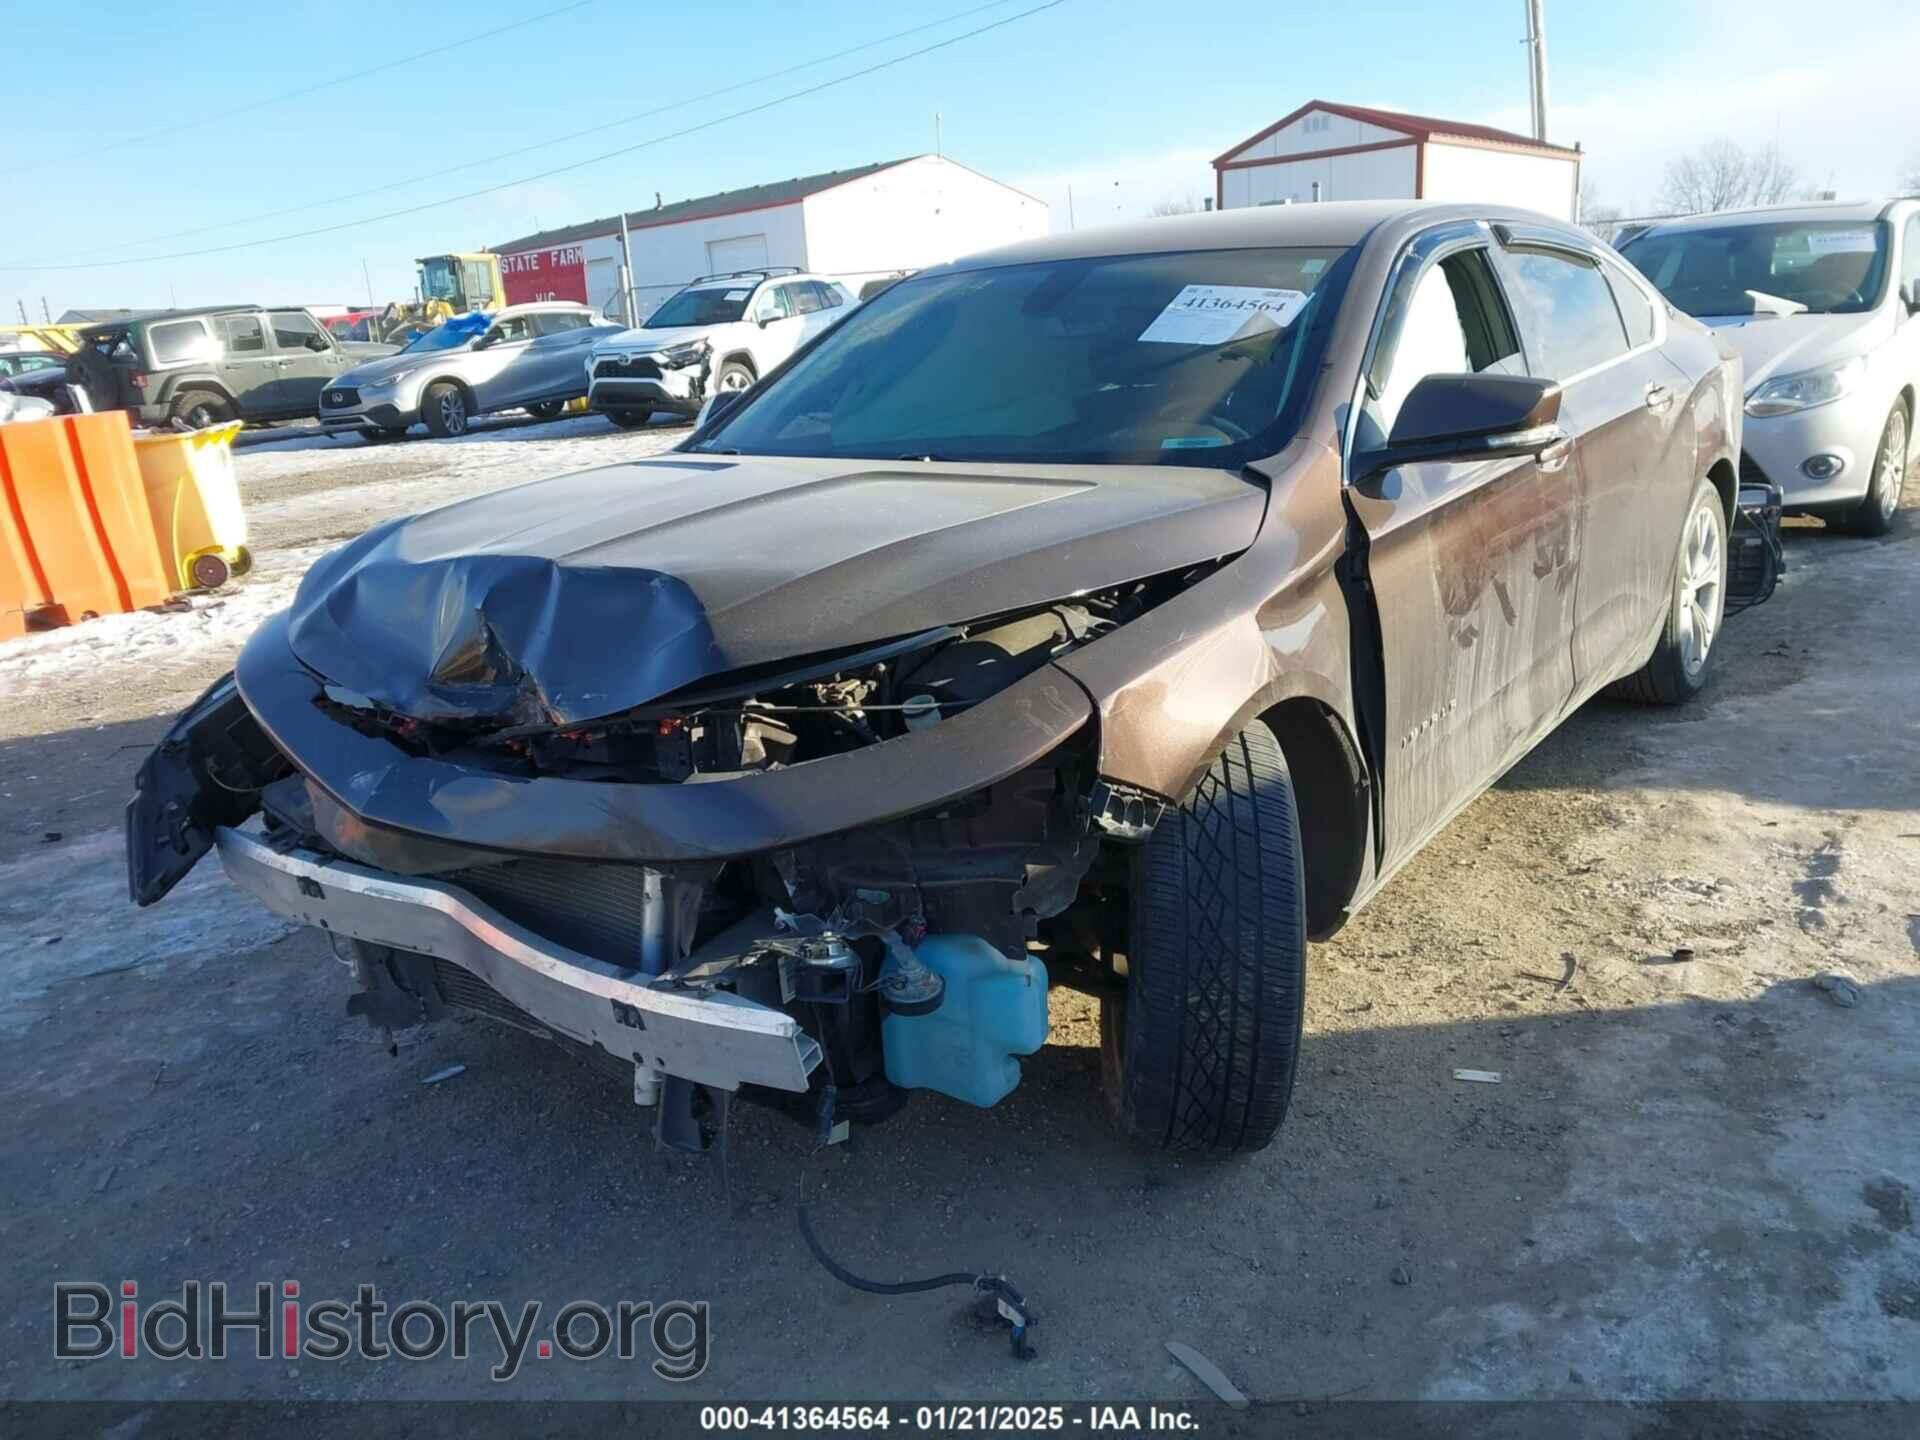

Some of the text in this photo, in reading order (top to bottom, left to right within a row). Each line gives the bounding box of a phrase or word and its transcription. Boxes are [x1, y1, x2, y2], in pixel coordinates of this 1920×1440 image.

[502, 246, 587, 273] STATE FARM
[1182, 297, 1287, 313] 41364564
